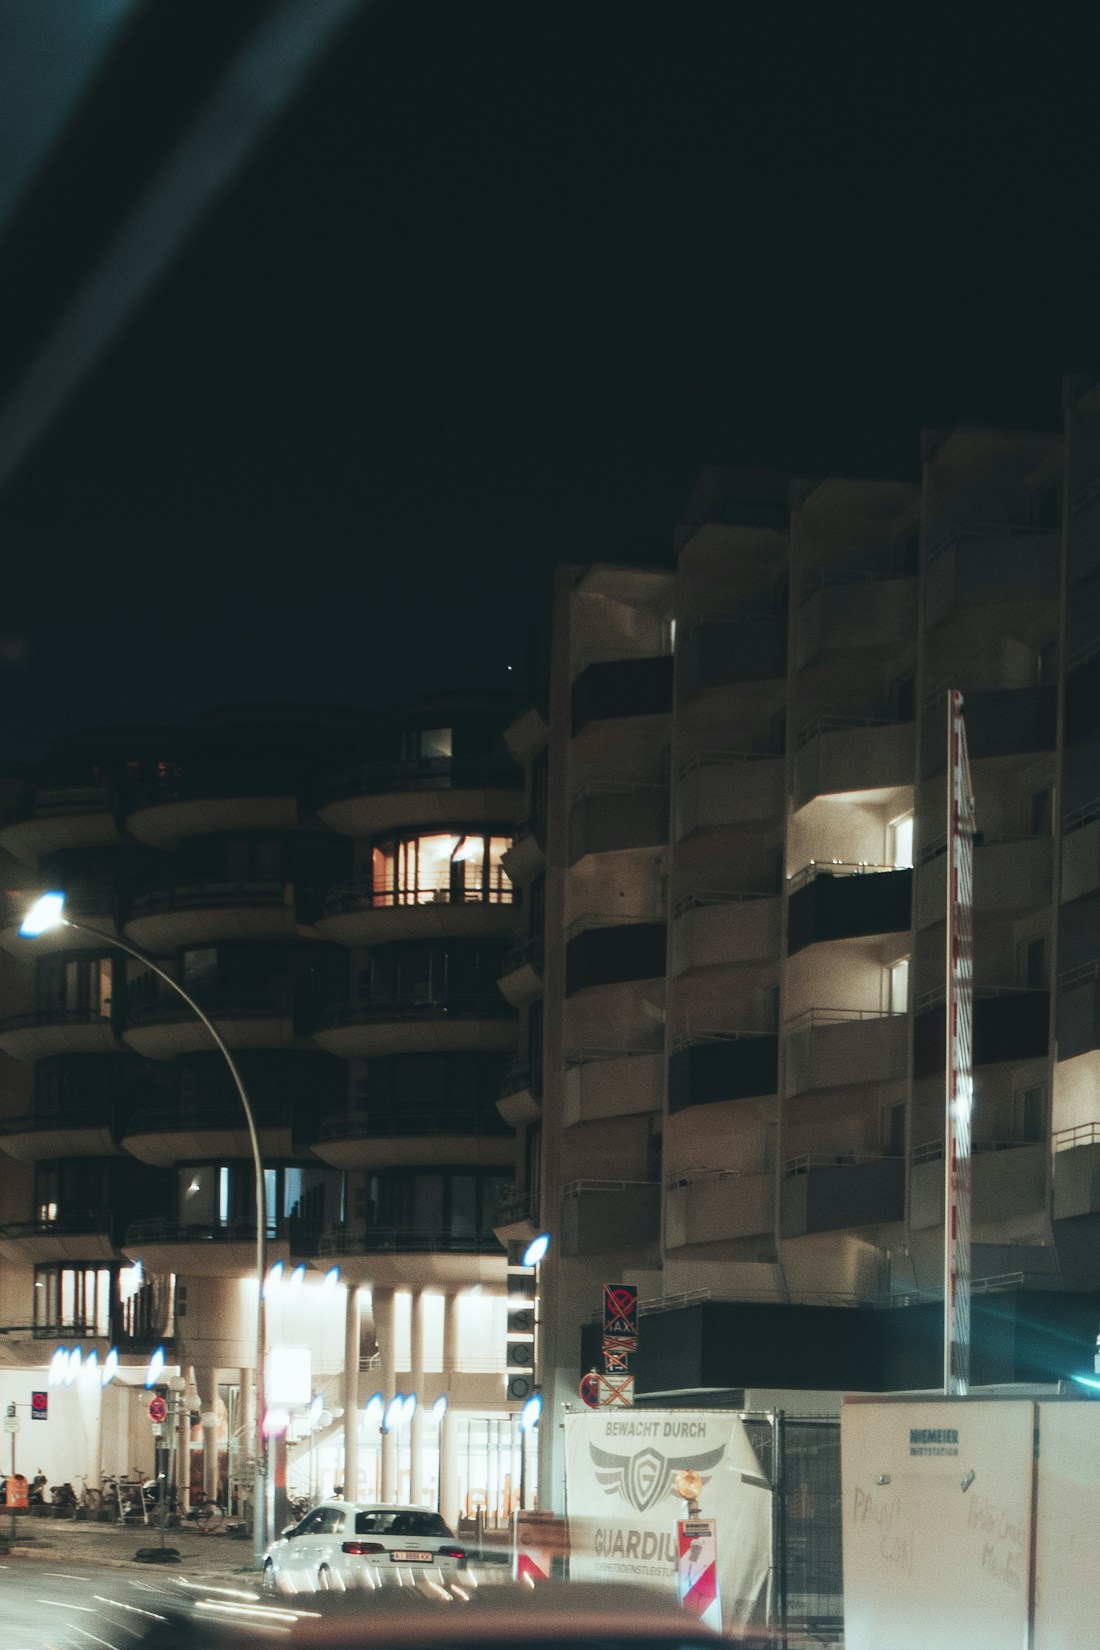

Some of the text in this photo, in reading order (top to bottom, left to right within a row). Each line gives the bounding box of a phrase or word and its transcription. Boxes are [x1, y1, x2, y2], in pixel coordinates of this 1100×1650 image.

[605, 1421, 707, 1438] BEWACHT DURCH
[909, 1428, 959, 1444] NIEMEIER
